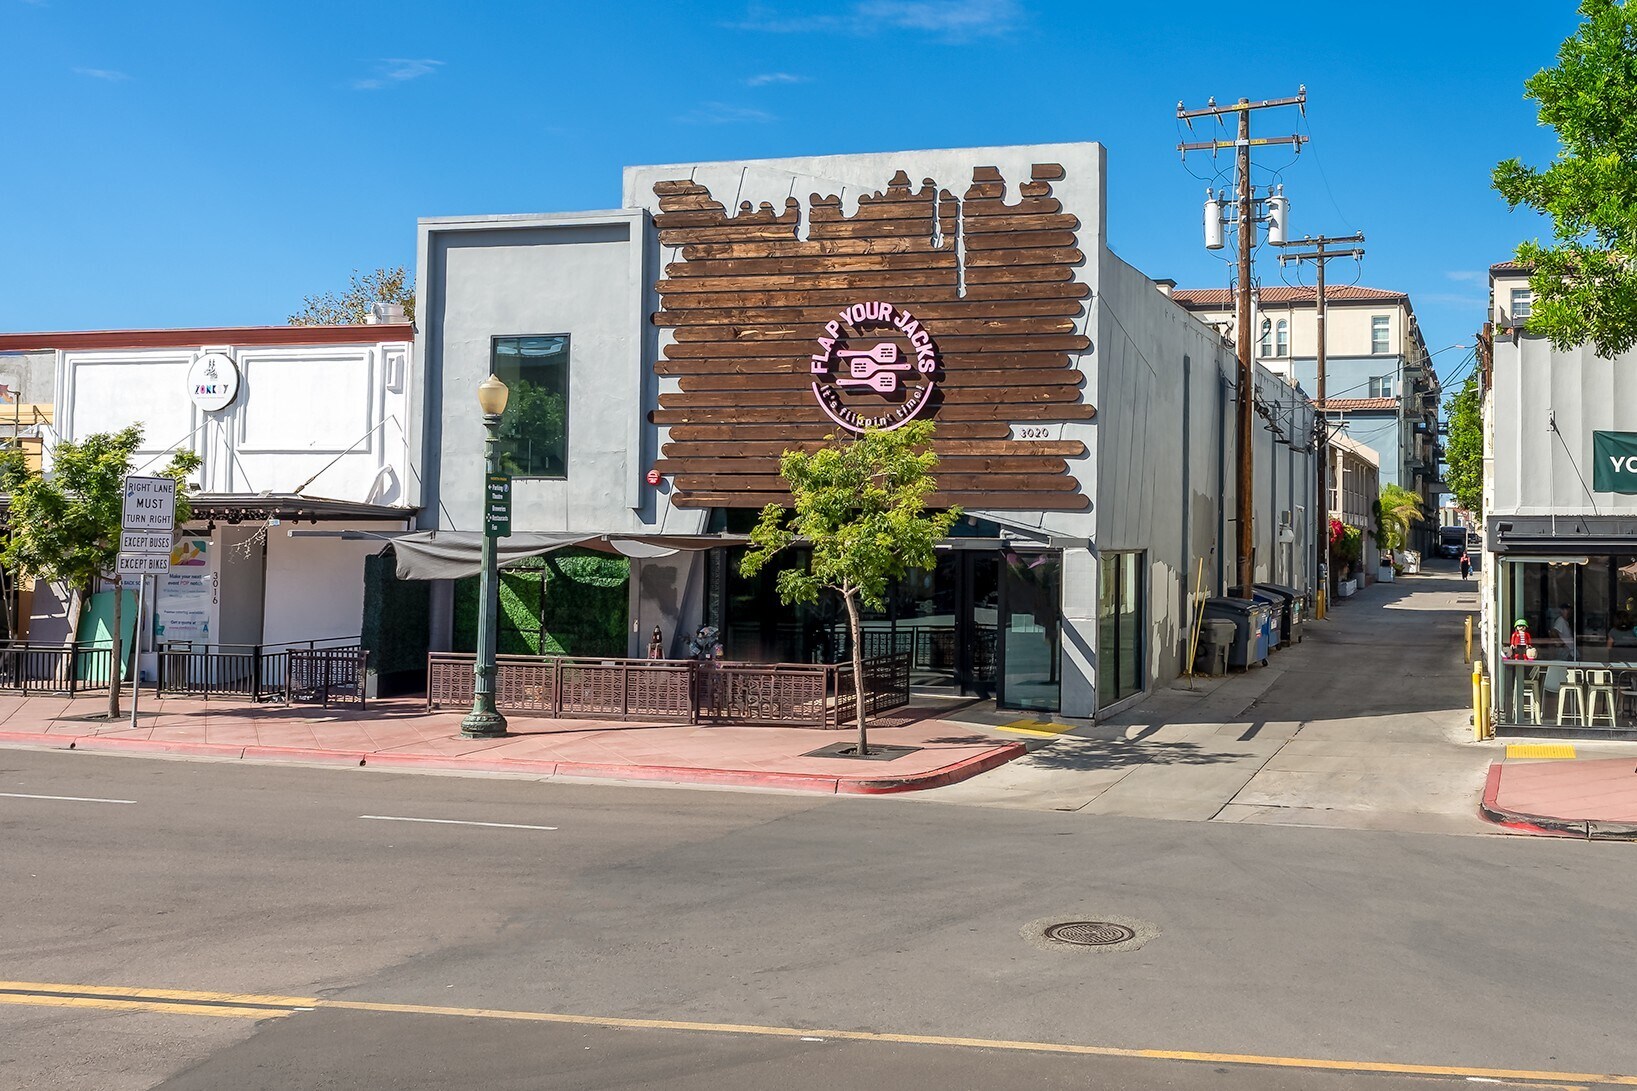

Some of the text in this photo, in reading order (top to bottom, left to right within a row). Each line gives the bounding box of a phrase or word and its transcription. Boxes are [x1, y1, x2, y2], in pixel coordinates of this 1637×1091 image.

[811, 301, 936, 374] FLAP YOUR JACKS
[195, 384, 229, 395] ZONKY
[820, 384, 925, 427] It's flippin' time!
[1020, 427, 1049, 439] 3020
[128, 482, 173, 493] RIGHT LANE
[492, 484, 504, 492] Parking
[136, 498, 164, 509] MUST
[126, 514, 171, 524] TURN RIGHT
[124, 536, 170, 548] EXCEPT BUSES
[120, 558, 168, 569] EXCEPT BIKES
[203, 624, 209, 632] A
